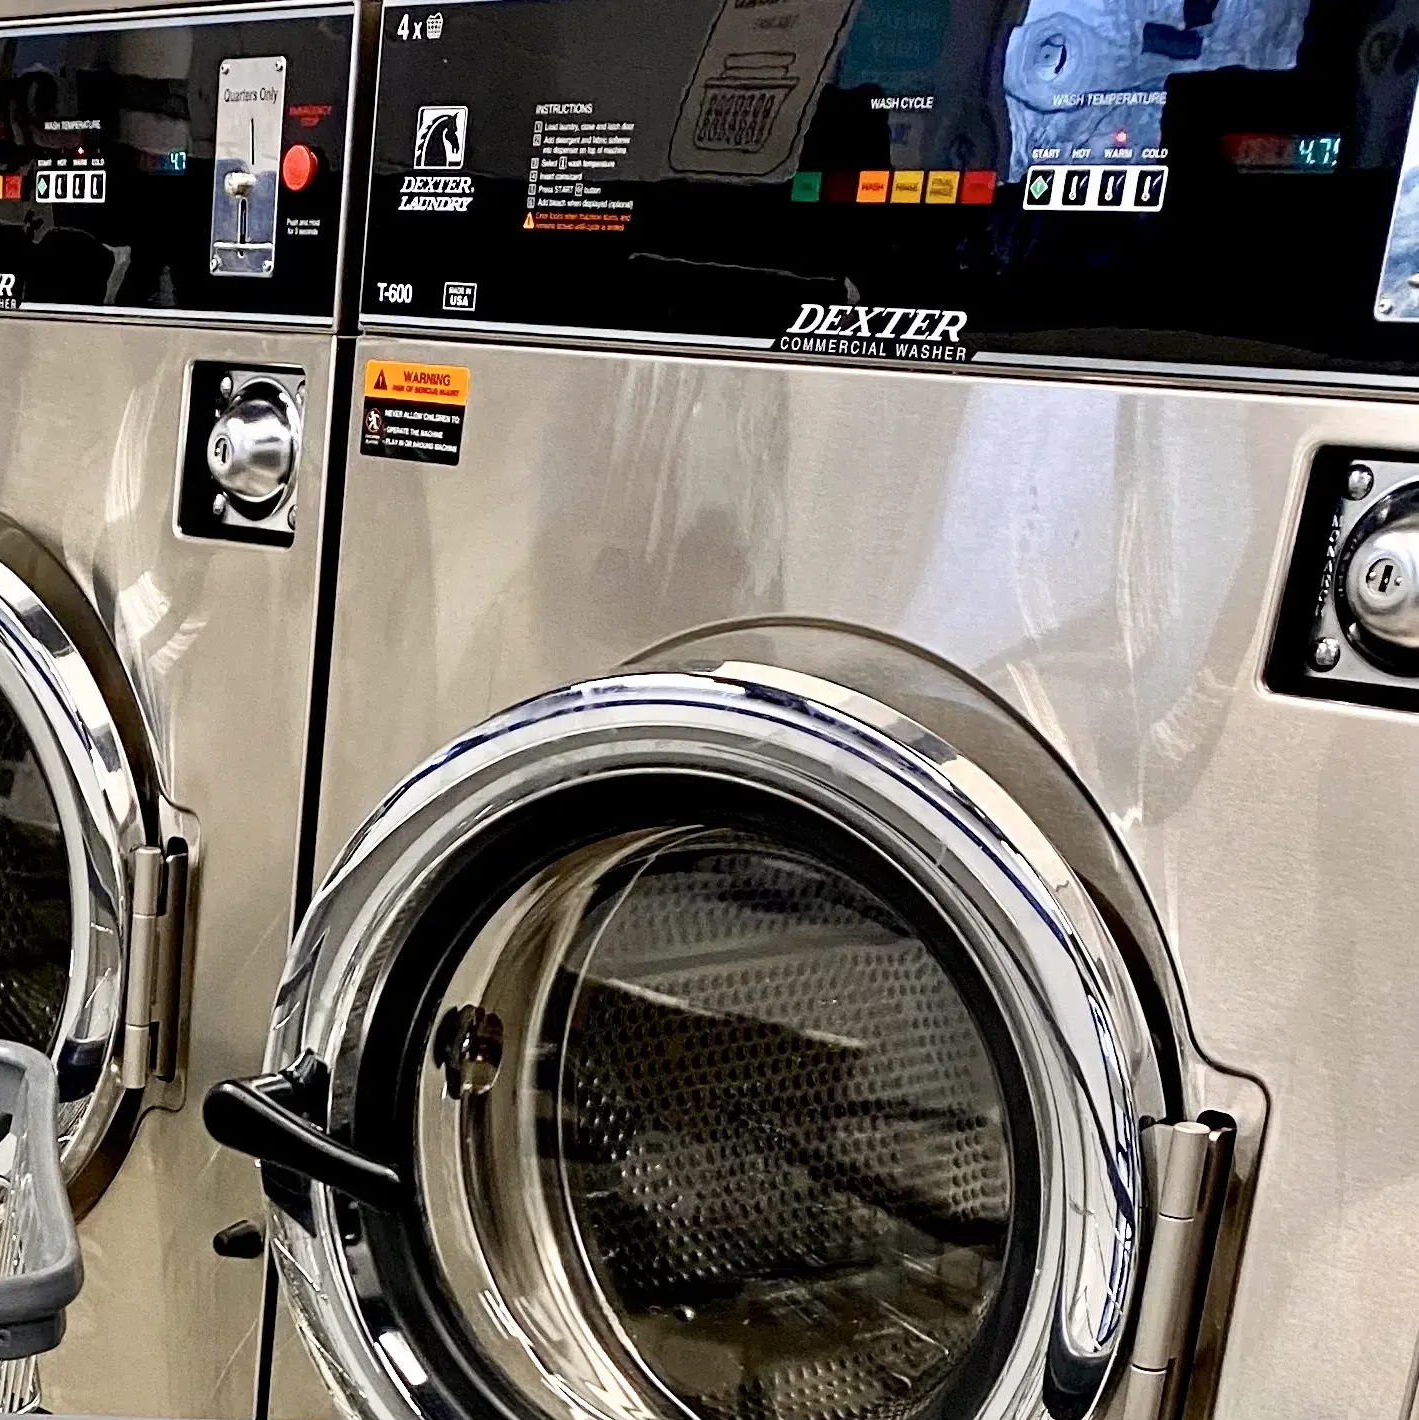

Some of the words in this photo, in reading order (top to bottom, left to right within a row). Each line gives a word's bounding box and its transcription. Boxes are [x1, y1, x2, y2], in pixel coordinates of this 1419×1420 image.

[224, 88, 257, 103] Quarters
[260, 87, 278, 104] Only
[870, 97, 899, 109] WASH
[900, 96, 934, 109] CYCLE
[1052, 94, 1083, 106] WASH
[1087, 92, 1167, 105] TEMPERATURE
[536, 103, 593, 114] INSTRUCTIONS
[1032, 149, 1060, 158] START
[1072, 149, 1092, 158] HOT
[1104, 149, 1133, 158] WARM
[1142, 148, 1168, 158] COLD
[400, 176, 474, 193] DEXTER
[398, 196, 473, 212] LAUNDRY
[377, 282, 413, 303] T-600
[450, 294, 469, 306] USA
[786, 303, 968, 343] DEXTER
[780, 336, 887, 357] COMMERCIAL
[895, 343, 967, 361] WASHER
[404, 371, 451, 386] WARNING
